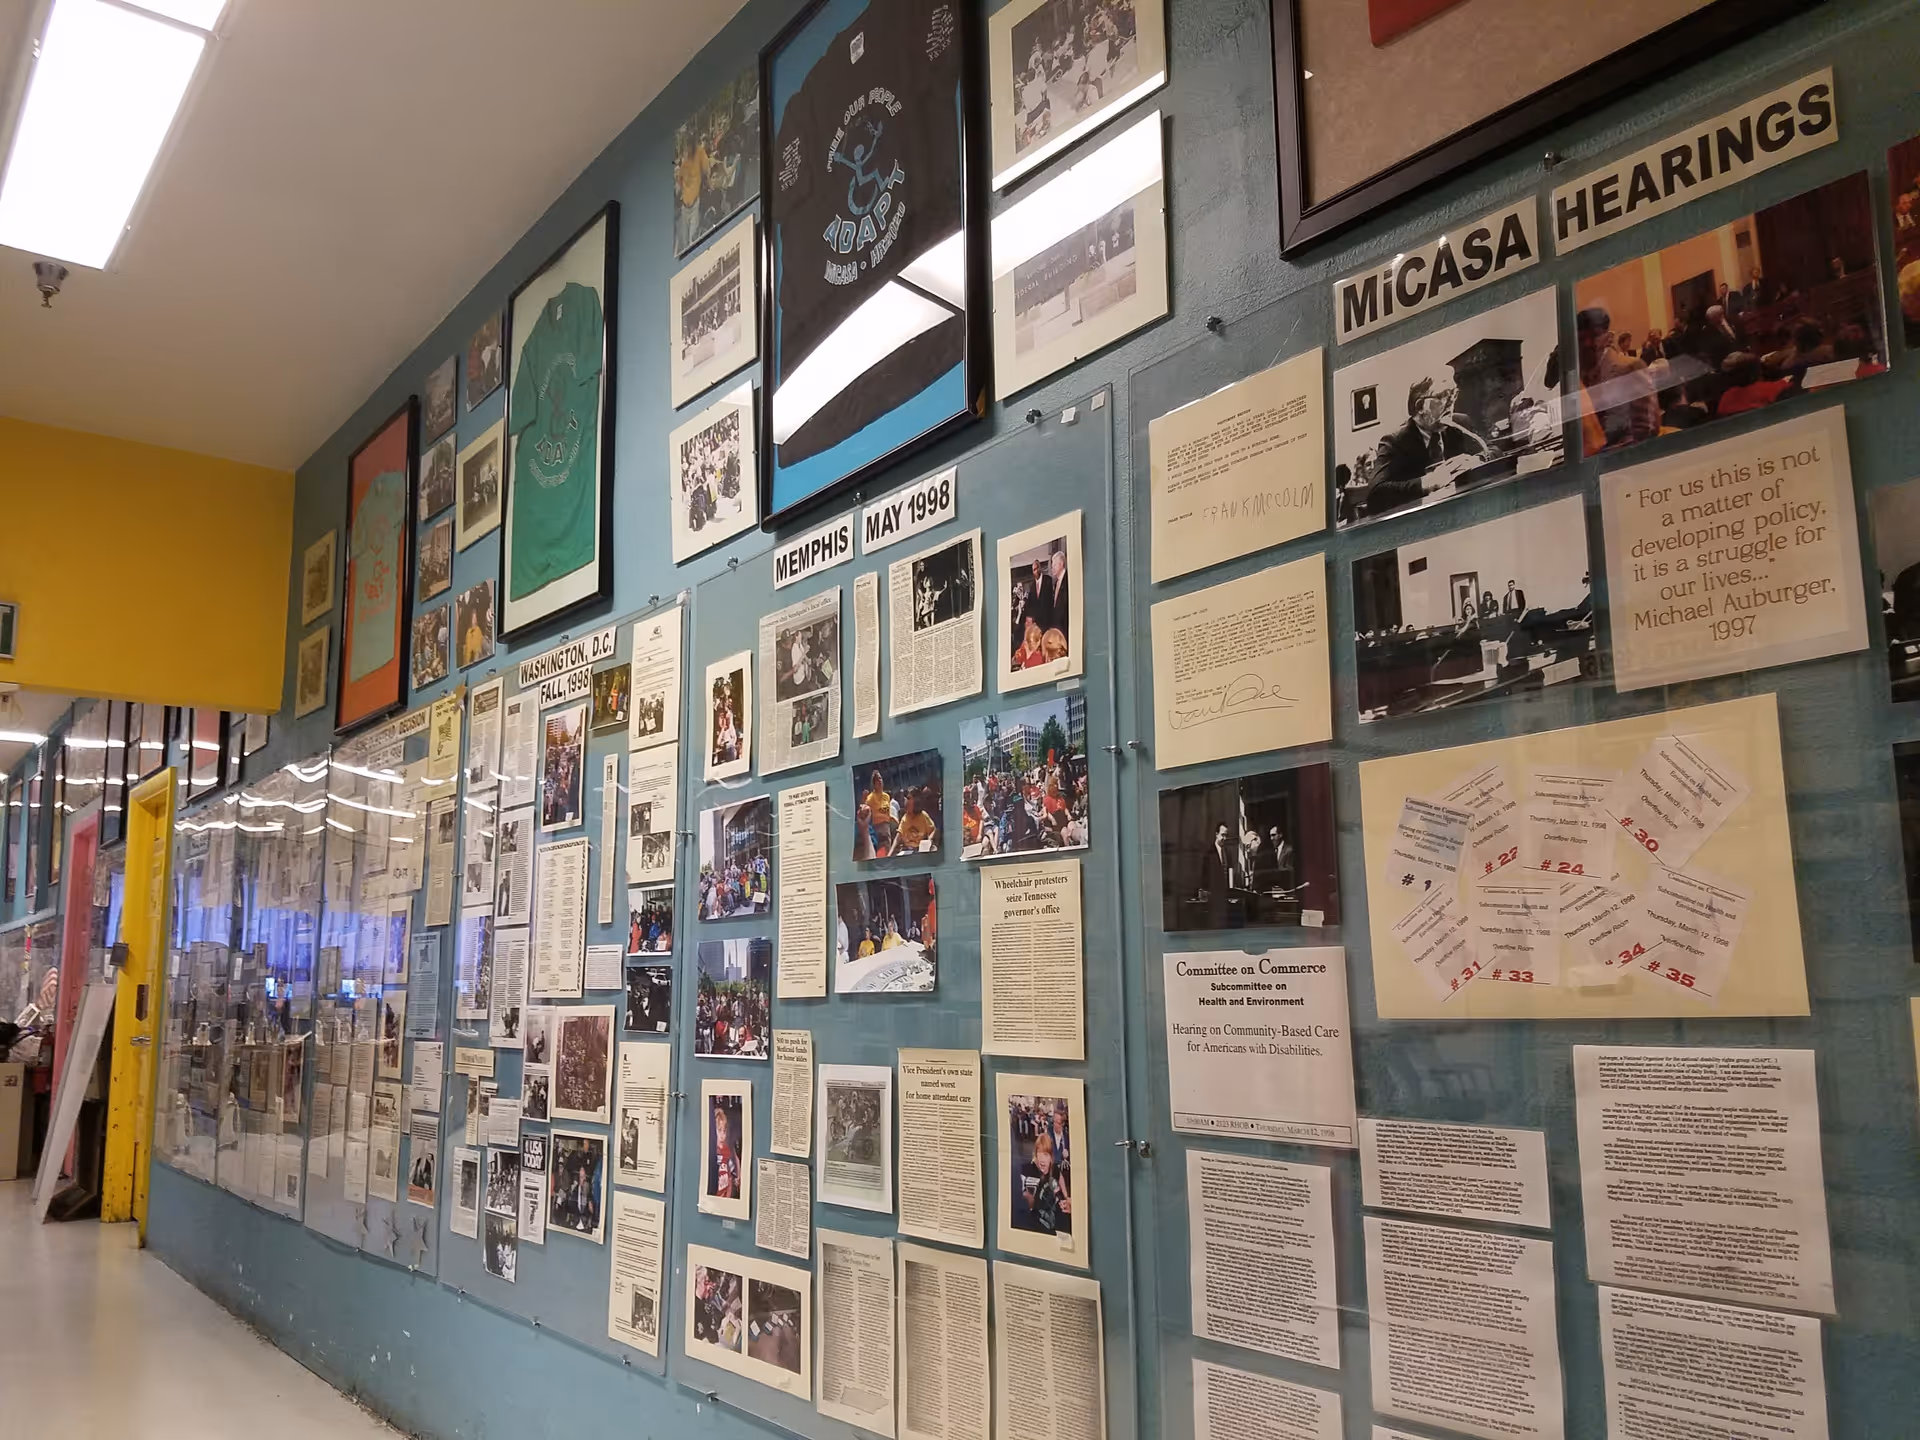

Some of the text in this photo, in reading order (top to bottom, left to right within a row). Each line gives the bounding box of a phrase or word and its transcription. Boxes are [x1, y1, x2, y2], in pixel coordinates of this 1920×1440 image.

[844, 95, 865, 125] OUR
[869, 87, 902, 116] PEOPLE
[823, 159, 904, 253] ADAPT
[1342, 84, 1832, 332] MiCASA HEARINGS
[1680, 479, 1704, 496] us
[1711, 465, 1751, 487] this
[1758, 458, 1775, 476] is
[1782, 446, 1820, 470] not
[866, 480, 949, 543] MAY 1998
[1661, 479, 1785, 527] a matter of
[1631, 519, 1744, 558] developing
[776, 526, 848, 583] MEMPHIS
[1634, 525, 1826, 582] it is a struggle for
[1660, 581, 1696, 600] our
[1635, 598, 1713, 630] Michael
[1709, 615, 1756, 641] 1997
[521, 633, 611, 684] WASHINGTON, D.C.
[541, 668, 589, 704] FALL, 1998
[1502, 801, 1516, 812] 1998
[1641, 795, 1678, 829] Overflow Room
[1664, 792, 1681, 808] March
[1691, 815, 1705, 829] 1998
[1472, 824, 1509, 848] Overflow Room
[1544, 834, 1569, 842] Overflow
[1634, 829, 1659, 852] 30
[1558, 862, 1584, 875] 24
[995, 876, 1068, 889] Wheelchair protesters
[1007, 892, 1057, 902] seize Tennessee
[1004, 905, 1060, 919] governor's office
[1564, 922, 1593, 938] Thursday,
[1592, 910, 1611, 922] March
[1620, 894, 1635, 906] 1998
[1589, 920, 1629, 945] Overflow Room
[1647, 910, 1677, 927] Thursday,
[1679, 922, 1702, 935] March
[1713, 936, 1729, 947] 1998
[1435, 934, 1449, 946] March
[1452, 939, 1466, 953] Room
[1619, 942, 1646, 965] 34
[1685, 945, 1705, 956] Room
[1176, 959, 1326, 976] Committee on Commerce
[1461, 961, 1481, 981] 31
[1509, 970, 1533, 983] 33
[1666, 968, 1695, 987] 35
[1211, 983, 1287, 991] Subcommittee on
[1199, 997, 1304, 1006] Health and Environment
[1172, 1023, 1339, 1039] Hearing on Community-Based Care
[1187, 1041, 1323, 1056] for Americans with Disabilities.
[917, 1066, 946, 1075] President's
[906, 1091, 914, 1099] for
[916, 1091, 931, 1100] home
[933, 1093, 958, 1101] attendant
[530, 1141, 542, 1155] USA
[524, 1153, 543, 1169] TODAY
